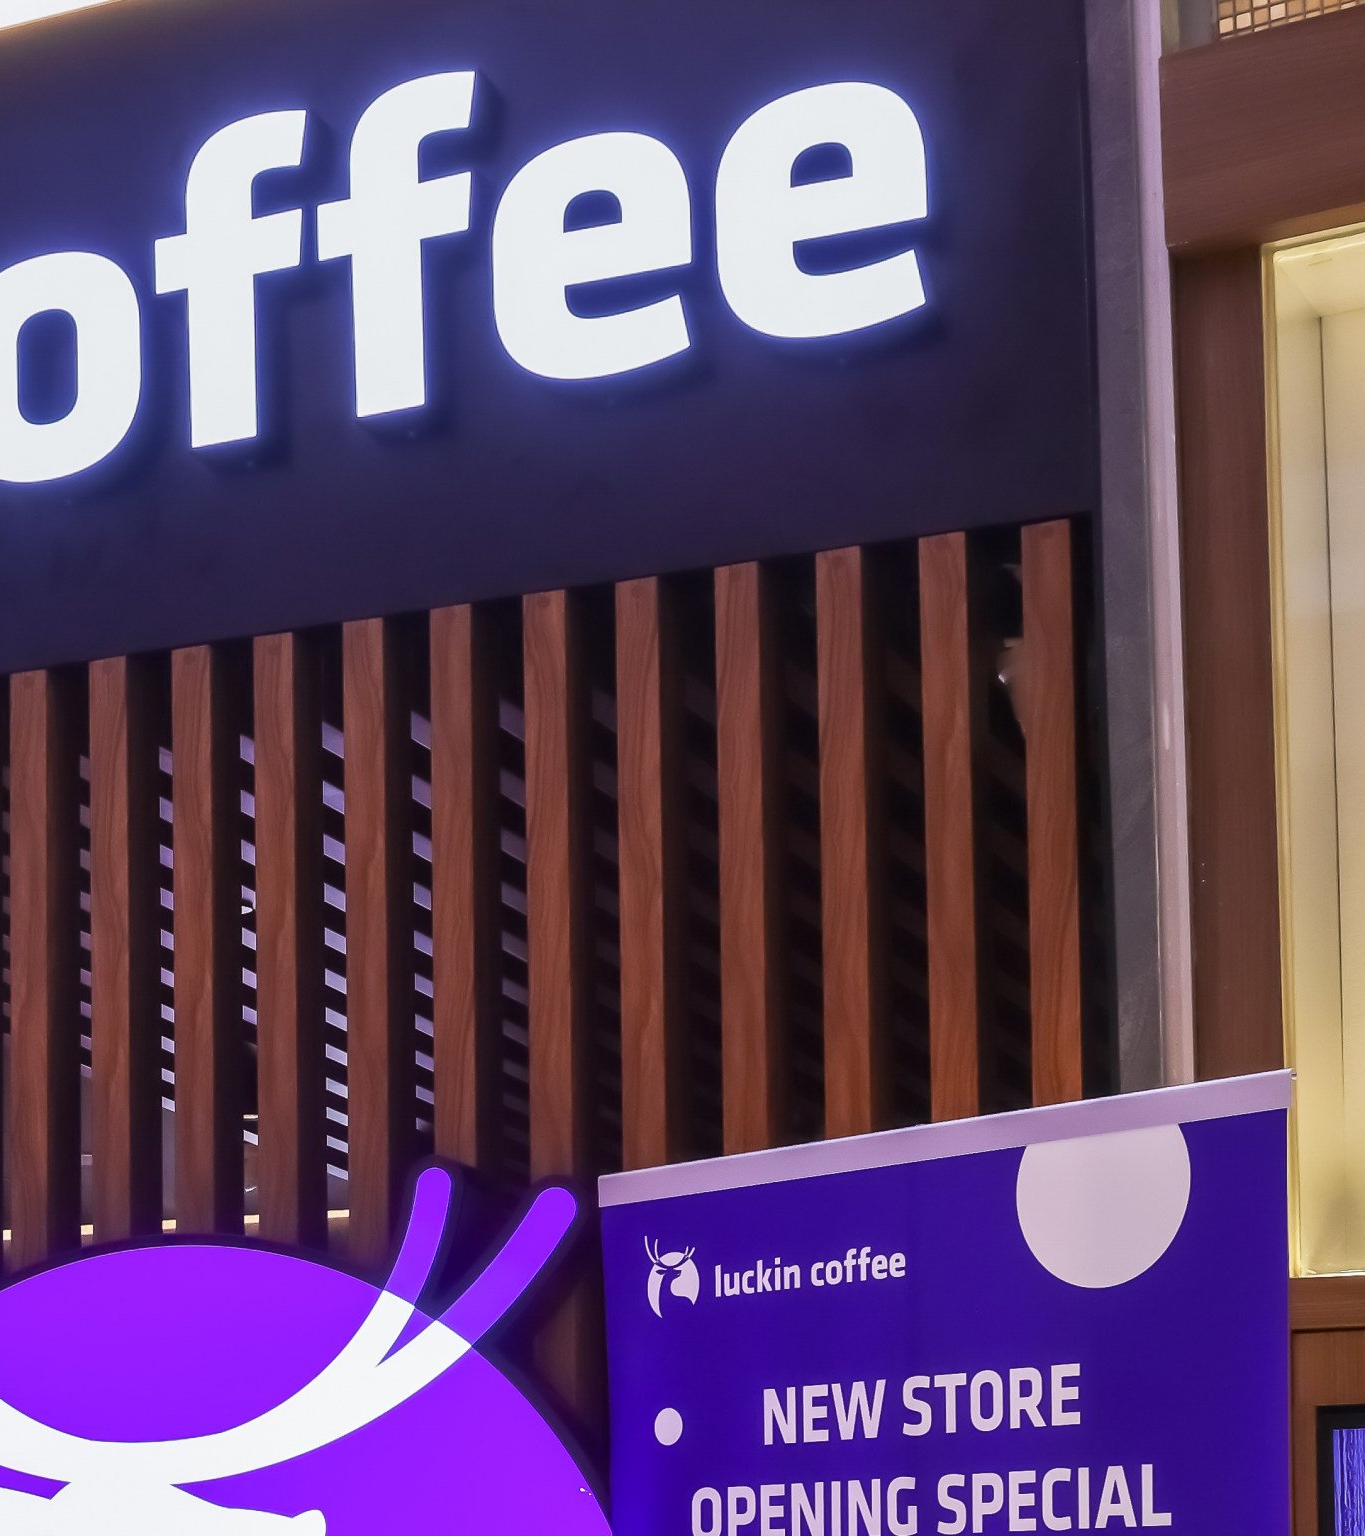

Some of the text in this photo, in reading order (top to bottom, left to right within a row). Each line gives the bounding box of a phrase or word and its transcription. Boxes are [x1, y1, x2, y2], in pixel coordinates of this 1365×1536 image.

[715, 1247, 905, 1297] luckin coffee
[764, 1363, 1080, 1445] NEW STORE
[937, 1464, 1171, 1535] SPECIAL
